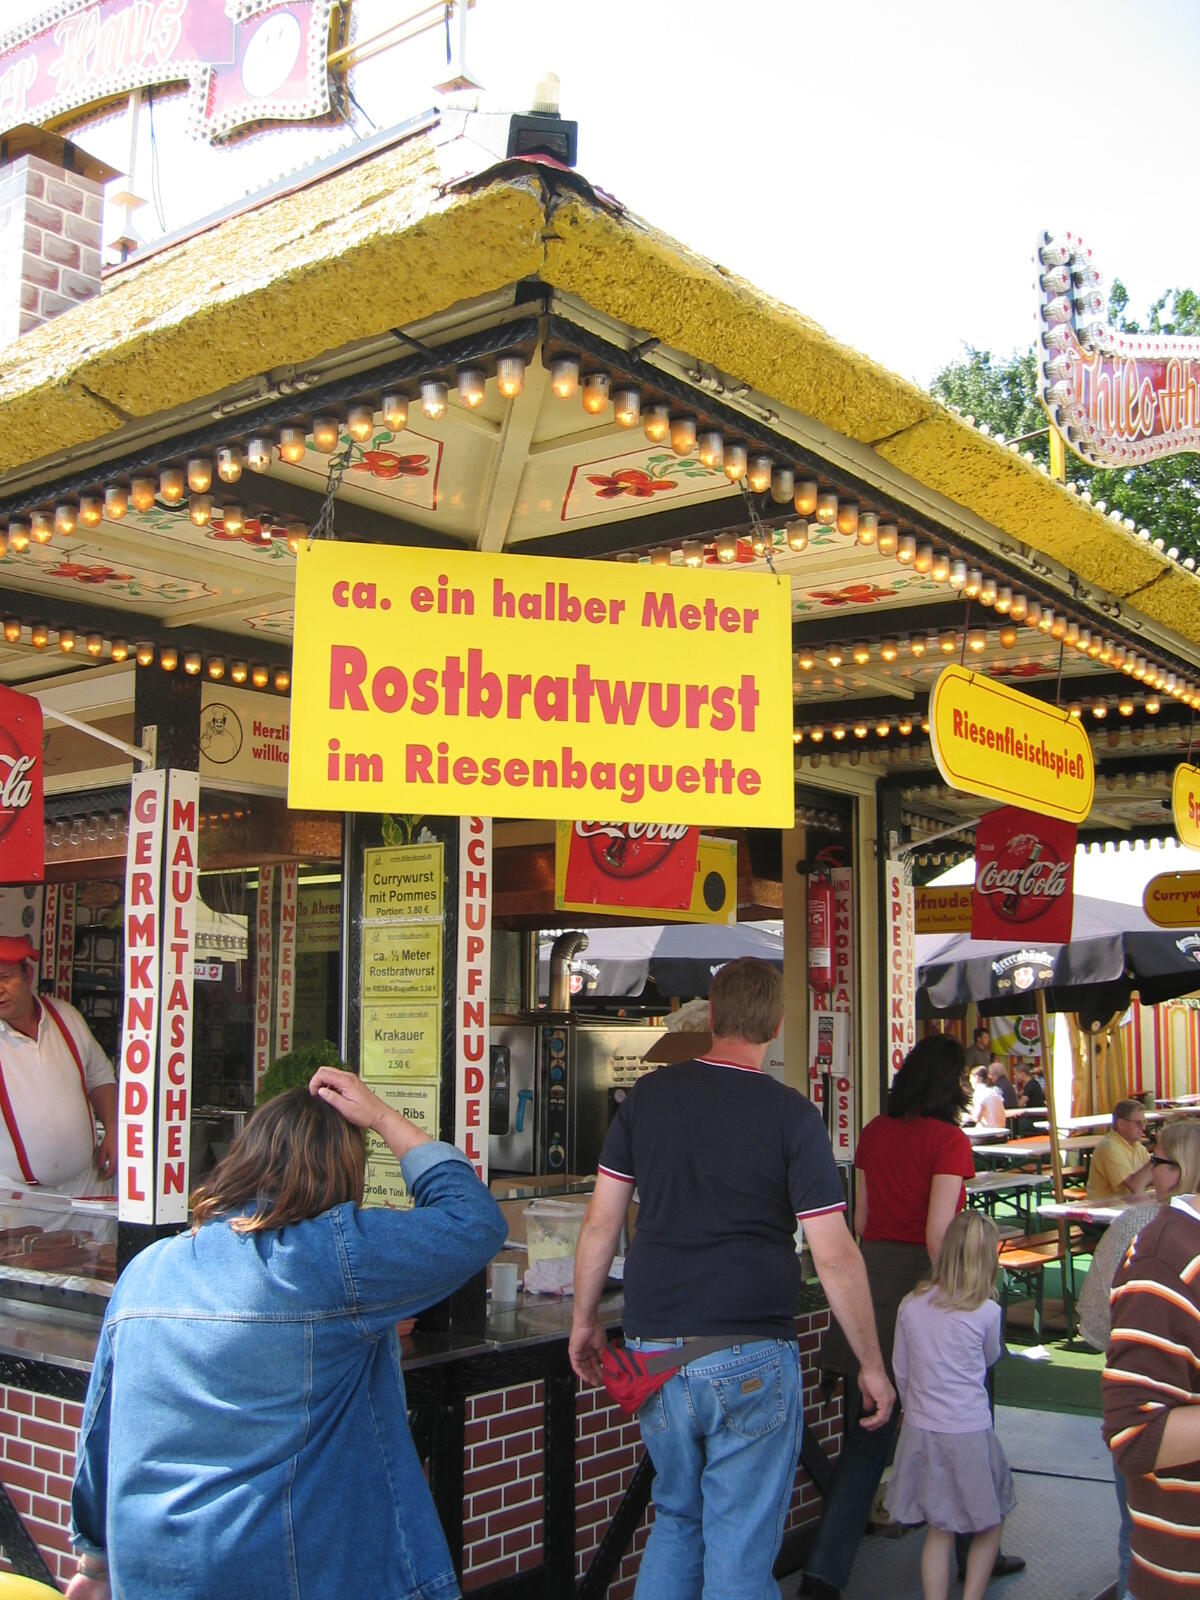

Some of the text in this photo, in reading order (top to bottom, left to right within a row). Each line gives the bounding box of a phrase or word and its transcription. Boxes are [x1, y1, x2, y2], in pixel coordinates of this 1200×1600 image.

[332, 574, 760, 634] ca. ein halber Meter
[329, 644, 760, 732] Rostbratwurst
[252, 720, 289, 742] Herzli
[251, 744, 289, 763] willko
[953, 707, 1085, 780] Riesenfleischspieß
[327, 738, 762, 803] im Riesenbaguette
[373, 871, 434, 887] Currywurst
[976, 861, 1072, 896] Coca-Cola
[369, 890, 437, 904] mit Pommes
[373, 952, 388, 962] ca.
[402, 949, 432, 961] Meter
[369, 966, 435, 977] Rostbratwurst
[124, 789, 157, 1201] GERMKNÖDEL
[163, 799, 195, 1195] MAULTASCHEN
[374, 1028, 425, 1041] Krakauer
[402, 1107, 425, 1120] Ribs
[364, 1184, 388, 1195] Große
